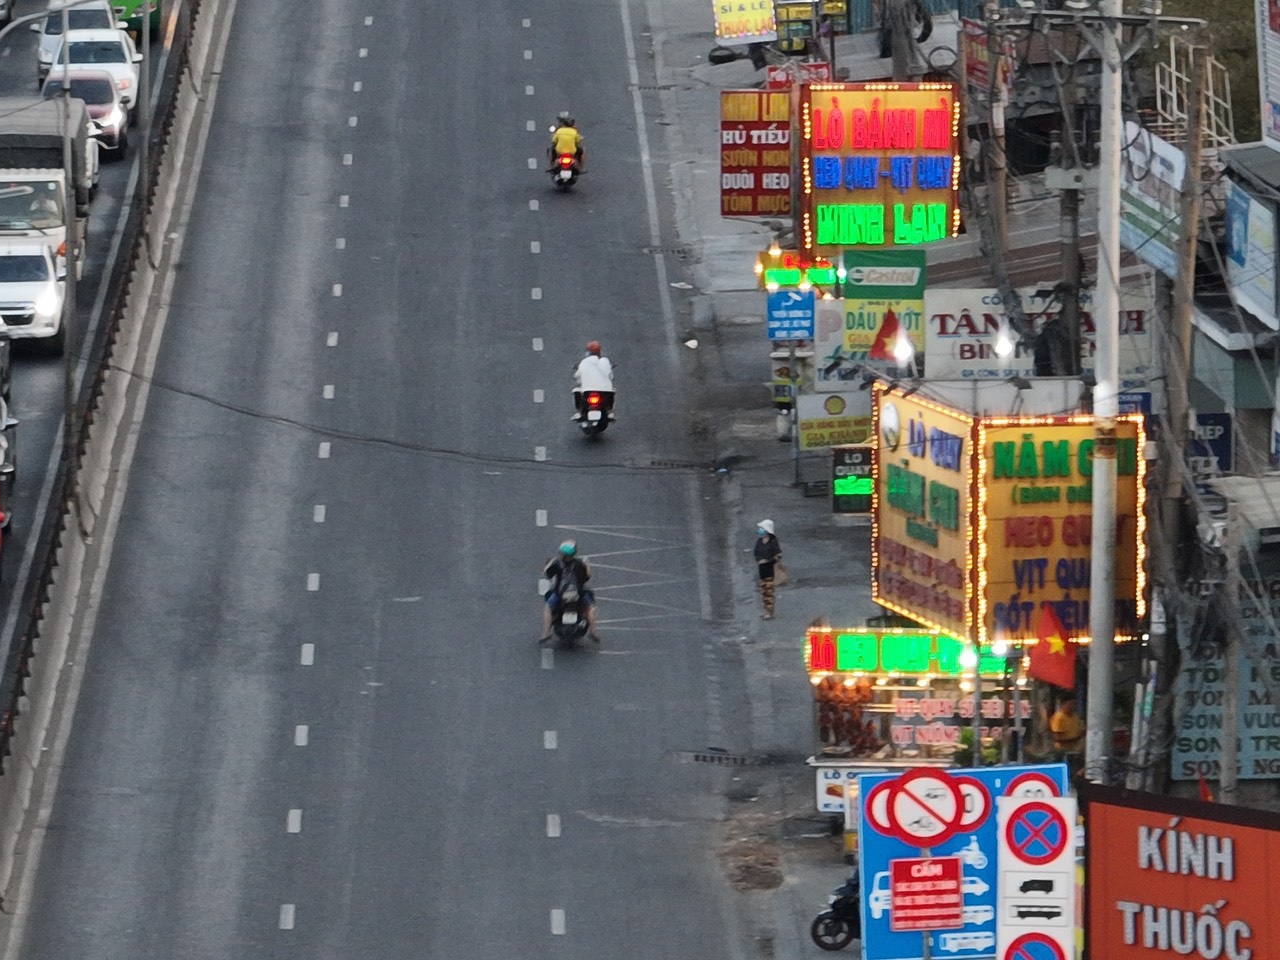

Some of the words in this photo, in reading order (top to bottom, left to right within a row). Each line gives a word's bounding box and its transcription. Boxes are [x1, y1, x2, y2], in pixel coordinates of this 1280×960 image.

[722, 125, 746, 144] HỦ
[750, 123, 789, 144] TIẾU
[813, 96, 844, 149] LÒ
[762, 173, 789, 189] HEO
[993, 433, 1069, 479] NĂM
[1004, 516, 1054, 547] HEO
[1138, 816, 1234, 881] KÍNH
[1116, 899, 1252, 960] THUỐC
